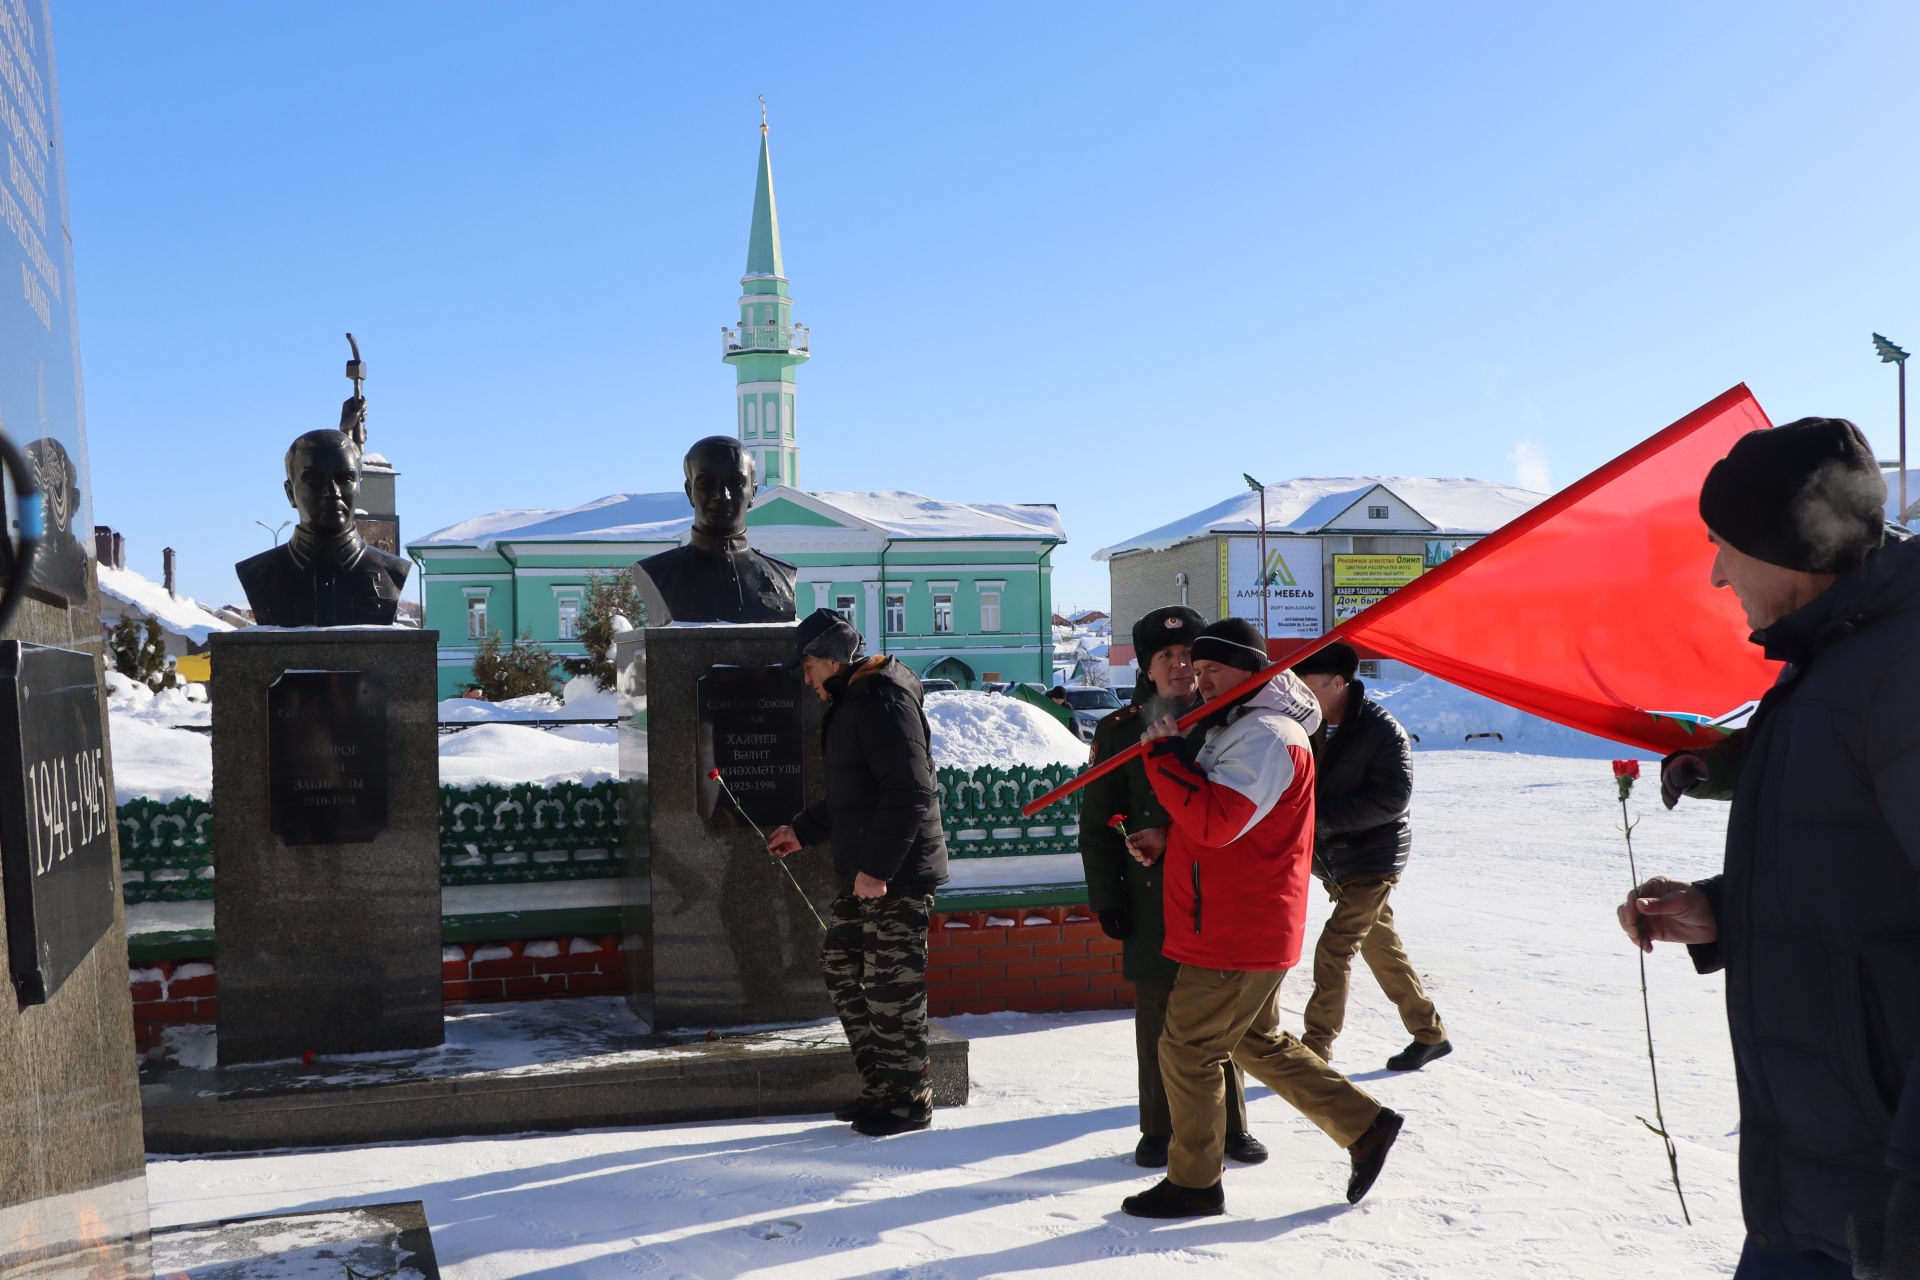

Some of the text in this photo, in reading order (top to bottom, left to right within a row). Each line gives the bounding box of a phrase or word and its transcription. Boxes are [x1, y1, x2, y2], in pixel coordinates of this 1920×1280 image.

[21, 261, 52, 332] ВОЙНЫ
[1396, 555, 1421, 564] Олимп
[1274, 589, 1314, 598] МЕБЕЛЬ
[1337, 595, 1383, 605] Дом быт
[733, 750, 771, 761] ВӘЛИТ
[777, 764, 801, 775] УЛЫ
[729, 780, 776, 791] 1925-1996
[29, 748, 107, 877] 1941-1945
